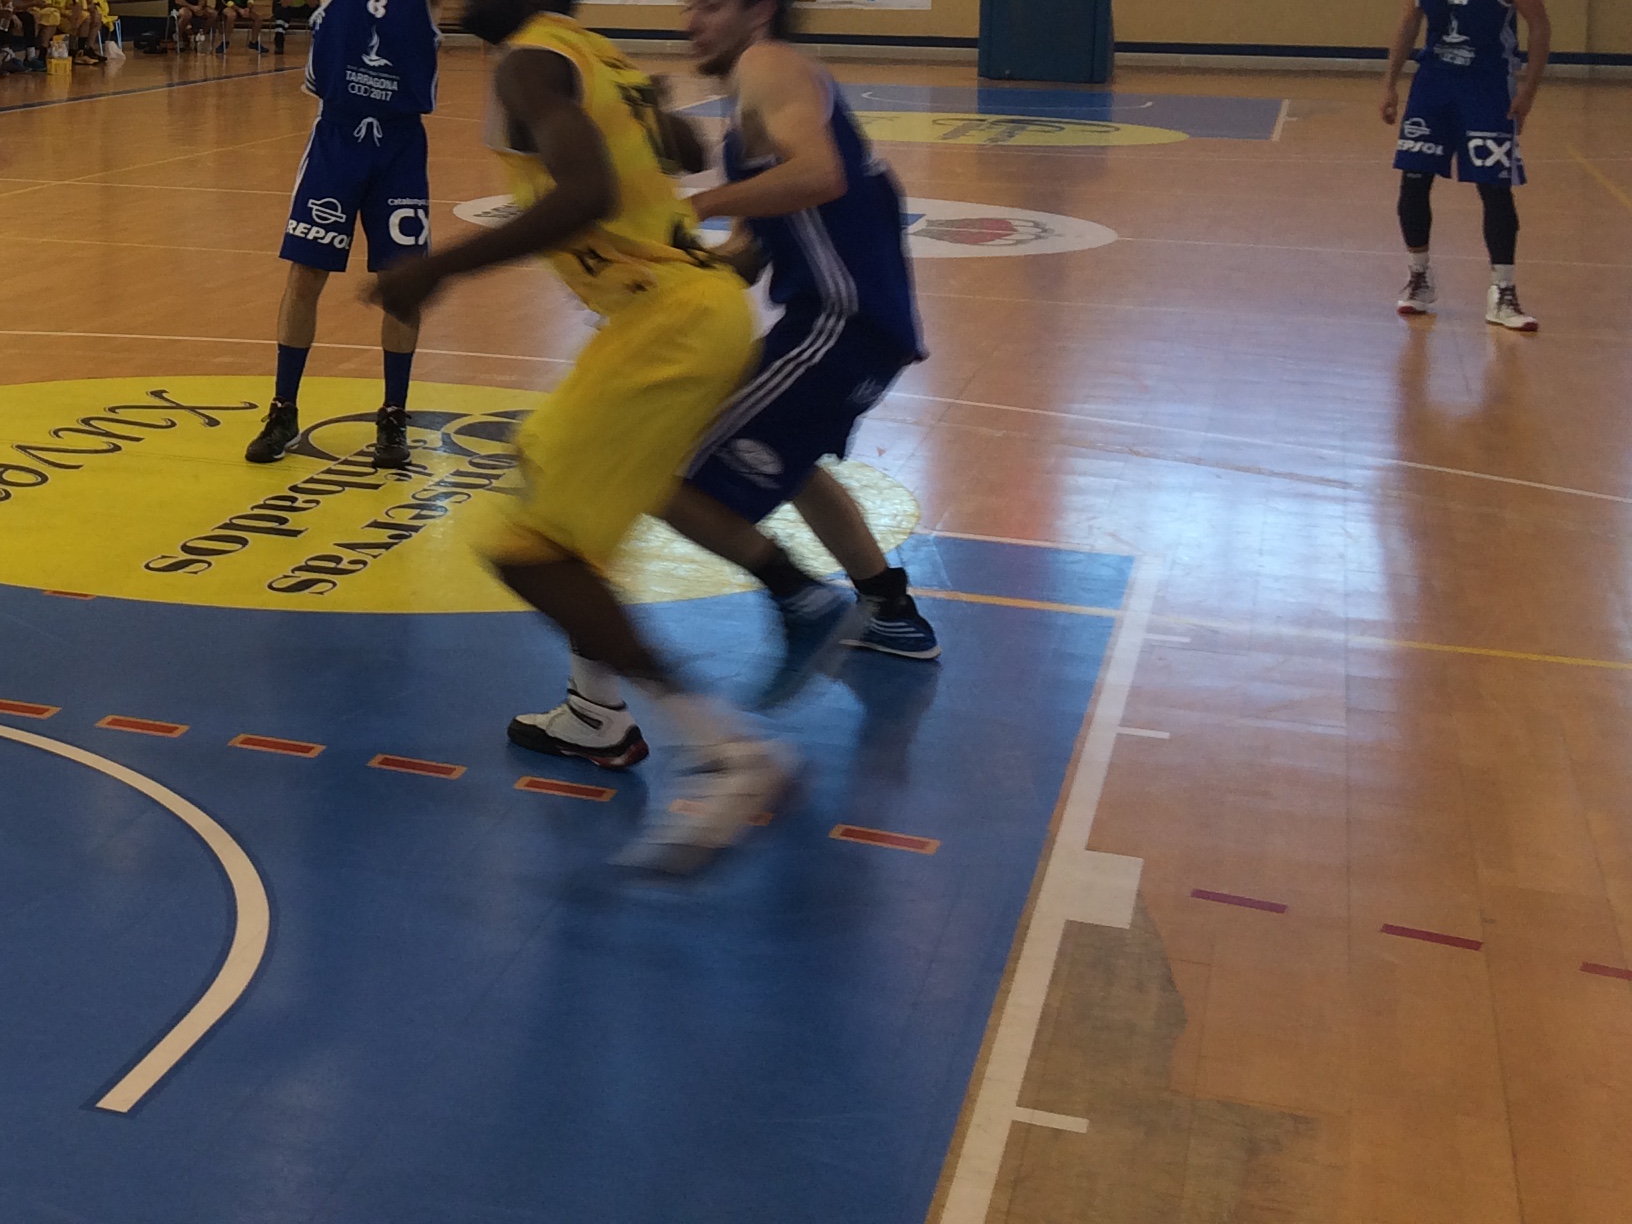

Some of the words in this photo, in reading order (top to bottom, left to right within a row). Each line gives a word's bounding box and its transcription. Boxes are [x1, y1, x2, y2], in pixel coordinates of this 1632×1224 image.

[345, 70, 399, 91] TARRAGONA
[369, 87, 393, 102] 2017
[1468, 137, 1512, 168] CX
